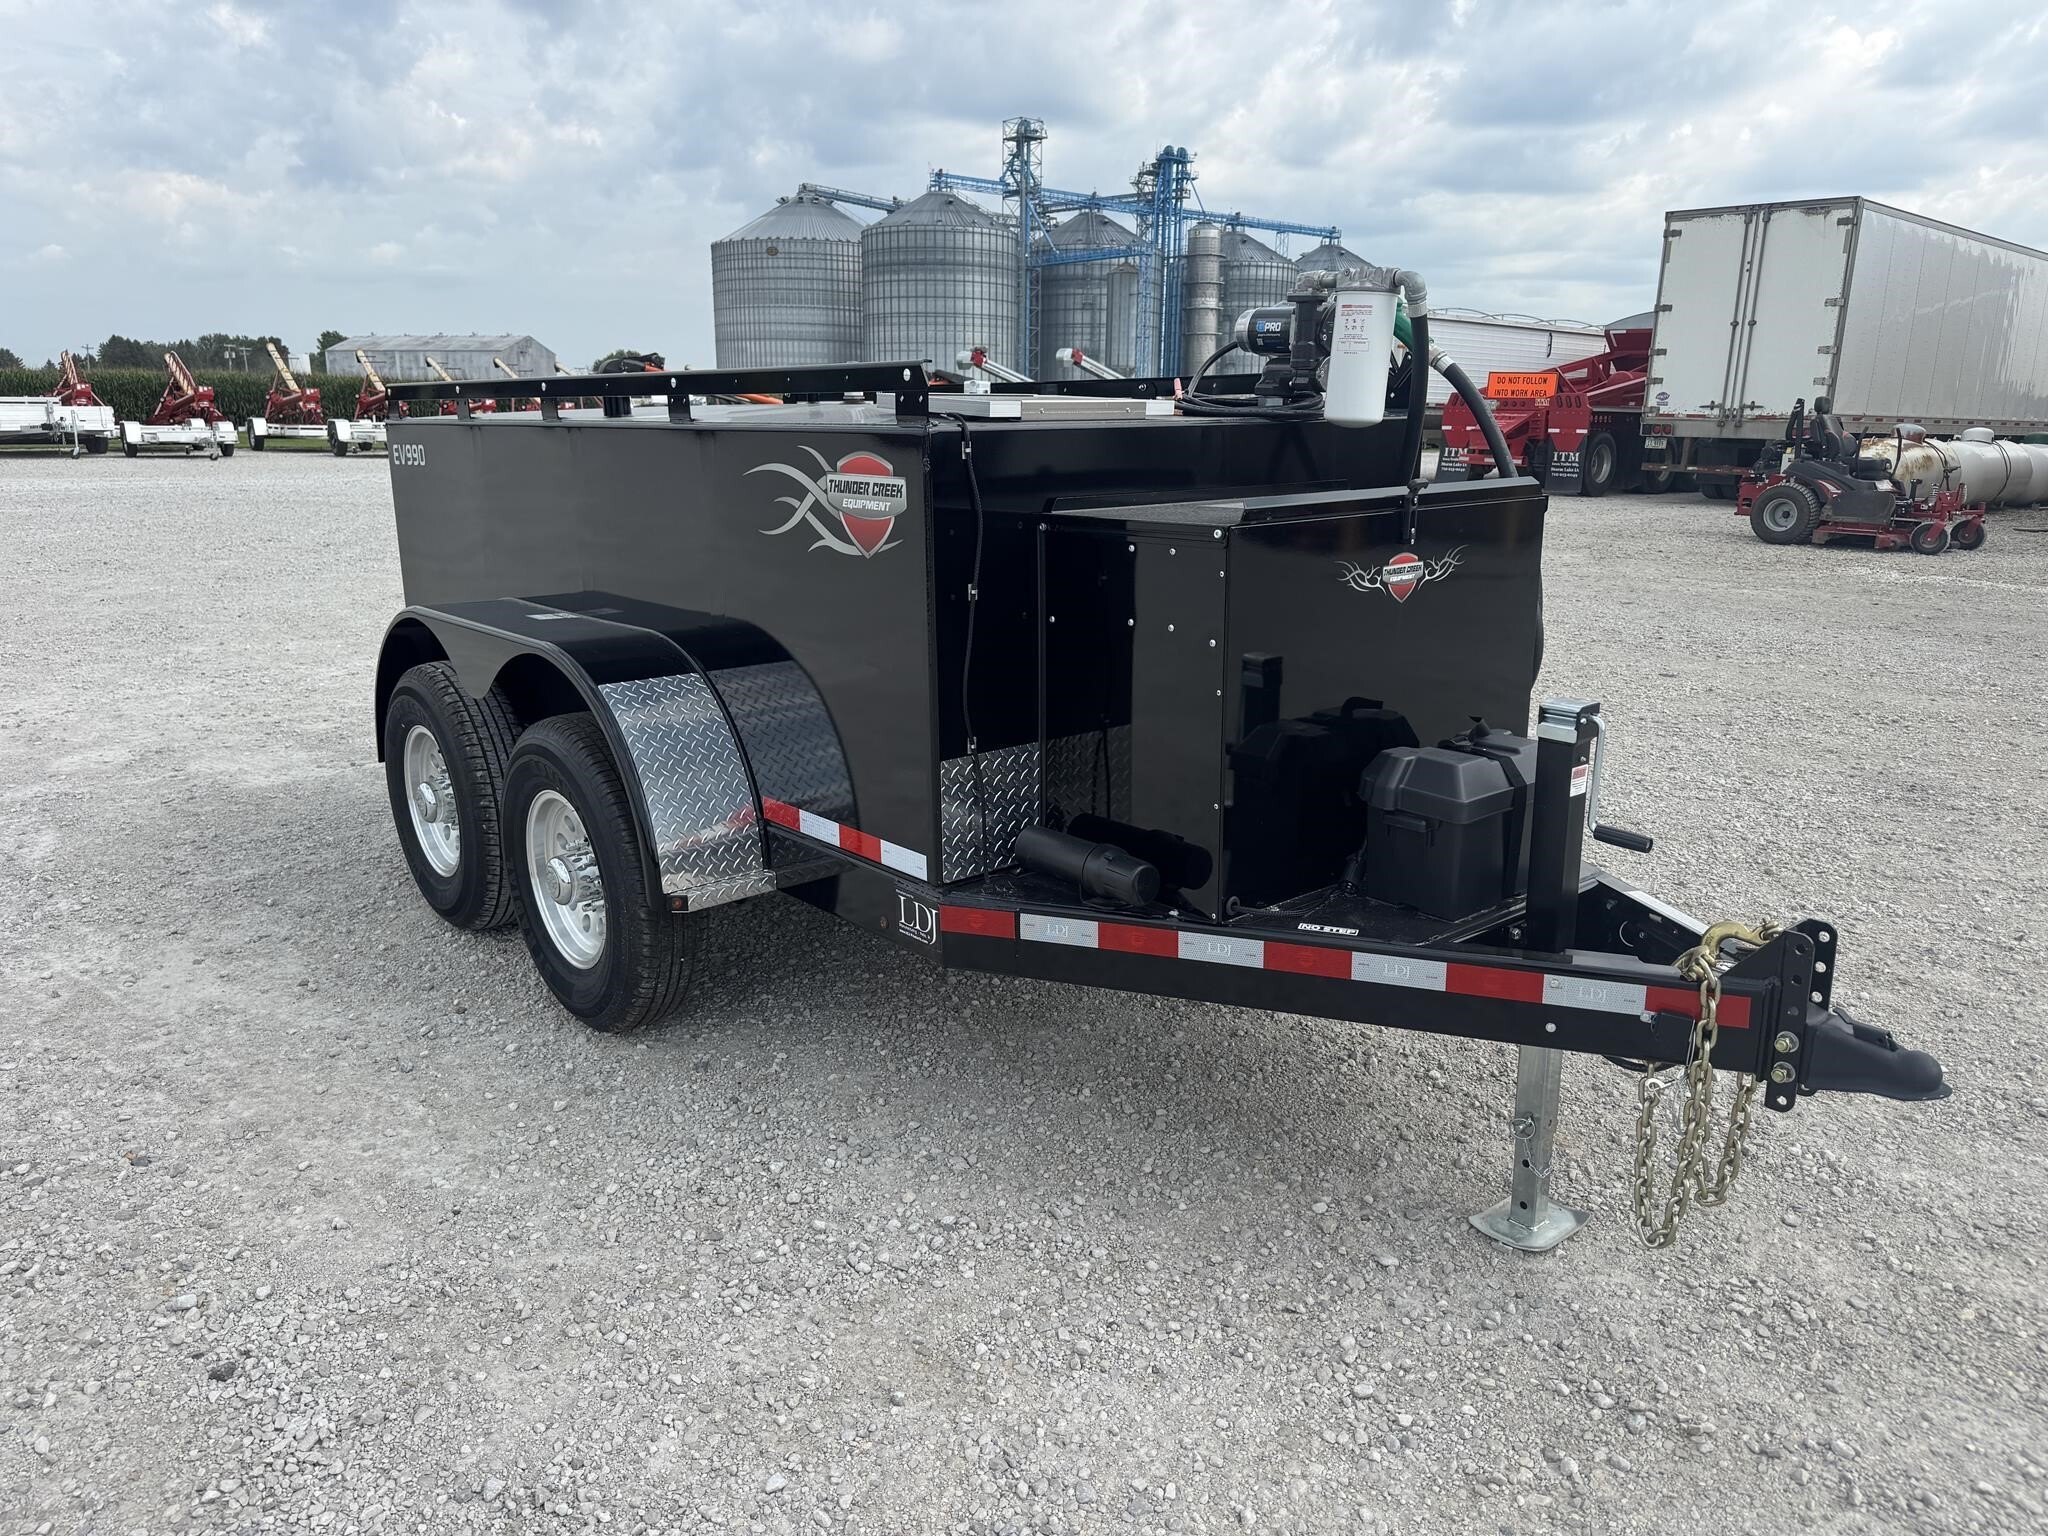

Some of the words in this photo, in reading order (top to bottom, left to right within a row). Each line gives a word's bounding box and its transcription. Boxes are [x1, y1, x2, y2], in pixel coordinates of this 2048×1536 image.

[1497, 376, 1506, 384] DO
[1508, 376, 1521, 384] NOT
[1522, 377, 1548, 385] FOLLOW
[1494, 388, 1508, 396] INTO
[1510, 389, 1529, 397] WORK
[1531, 389, 1547, 397] AREA
[392, 444, 426, 466] EV990
[1443, 447, 1468, 457] ITM
[1552, 451, 1580, 462] ITM
[828, 479, 871, 496] THUNDER
[872, 482, 904, 499] CREEK
[842, 498, 891, 511] EQUIPMENT
[1384, 566, 1406, 576] THUNDER
[1406, 564, 1422, 573] CREEK
[898, 895, 940, 945] LDJ
[1046, 923, 1069, 938] LDJ
[1300, 923, 1321, 931] NO
[1322, 925, 1357, 936] STEP
[1207, 942, 1232, 957] LDJ
[1383, 963, 1410, 979] LDJ
